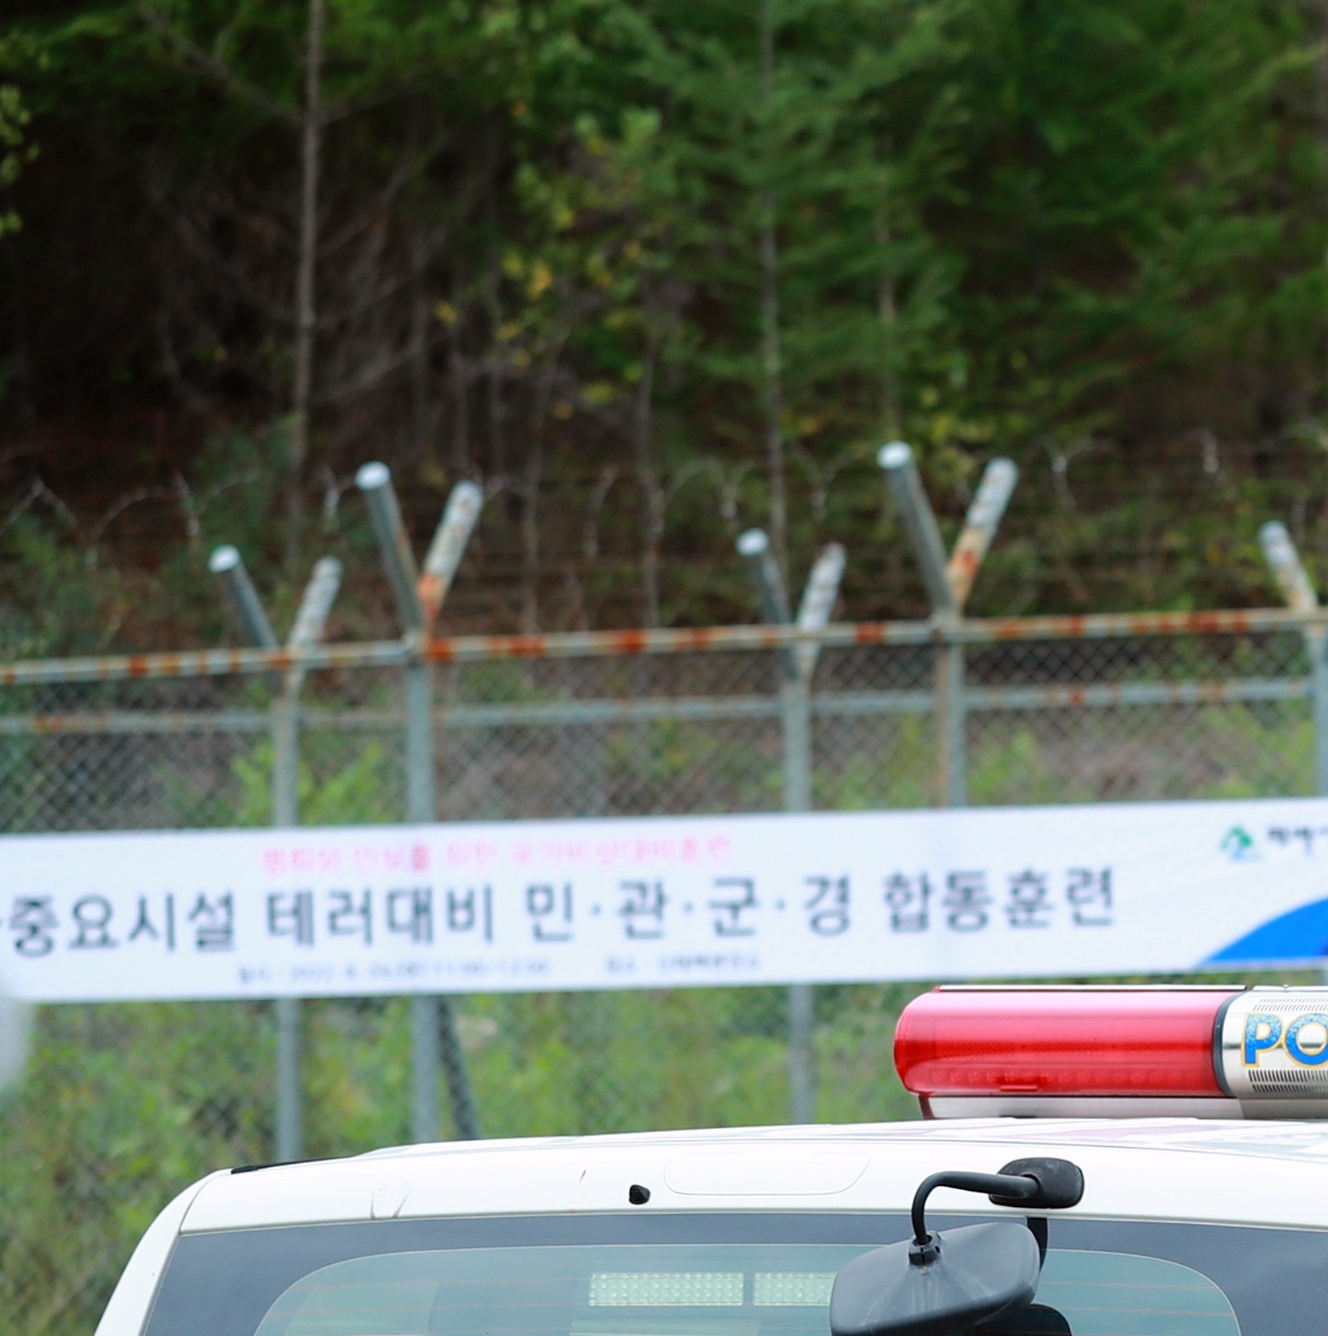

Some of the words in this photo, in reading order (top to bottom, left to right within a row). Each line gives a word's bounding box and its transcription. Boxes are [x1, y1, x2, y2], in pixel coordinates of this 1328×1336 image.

[8, 891, 235, 958] 중요시설
[266, 885, 496, 948] 테러대비
[882, 866, 1116, 934] 합동훈련
